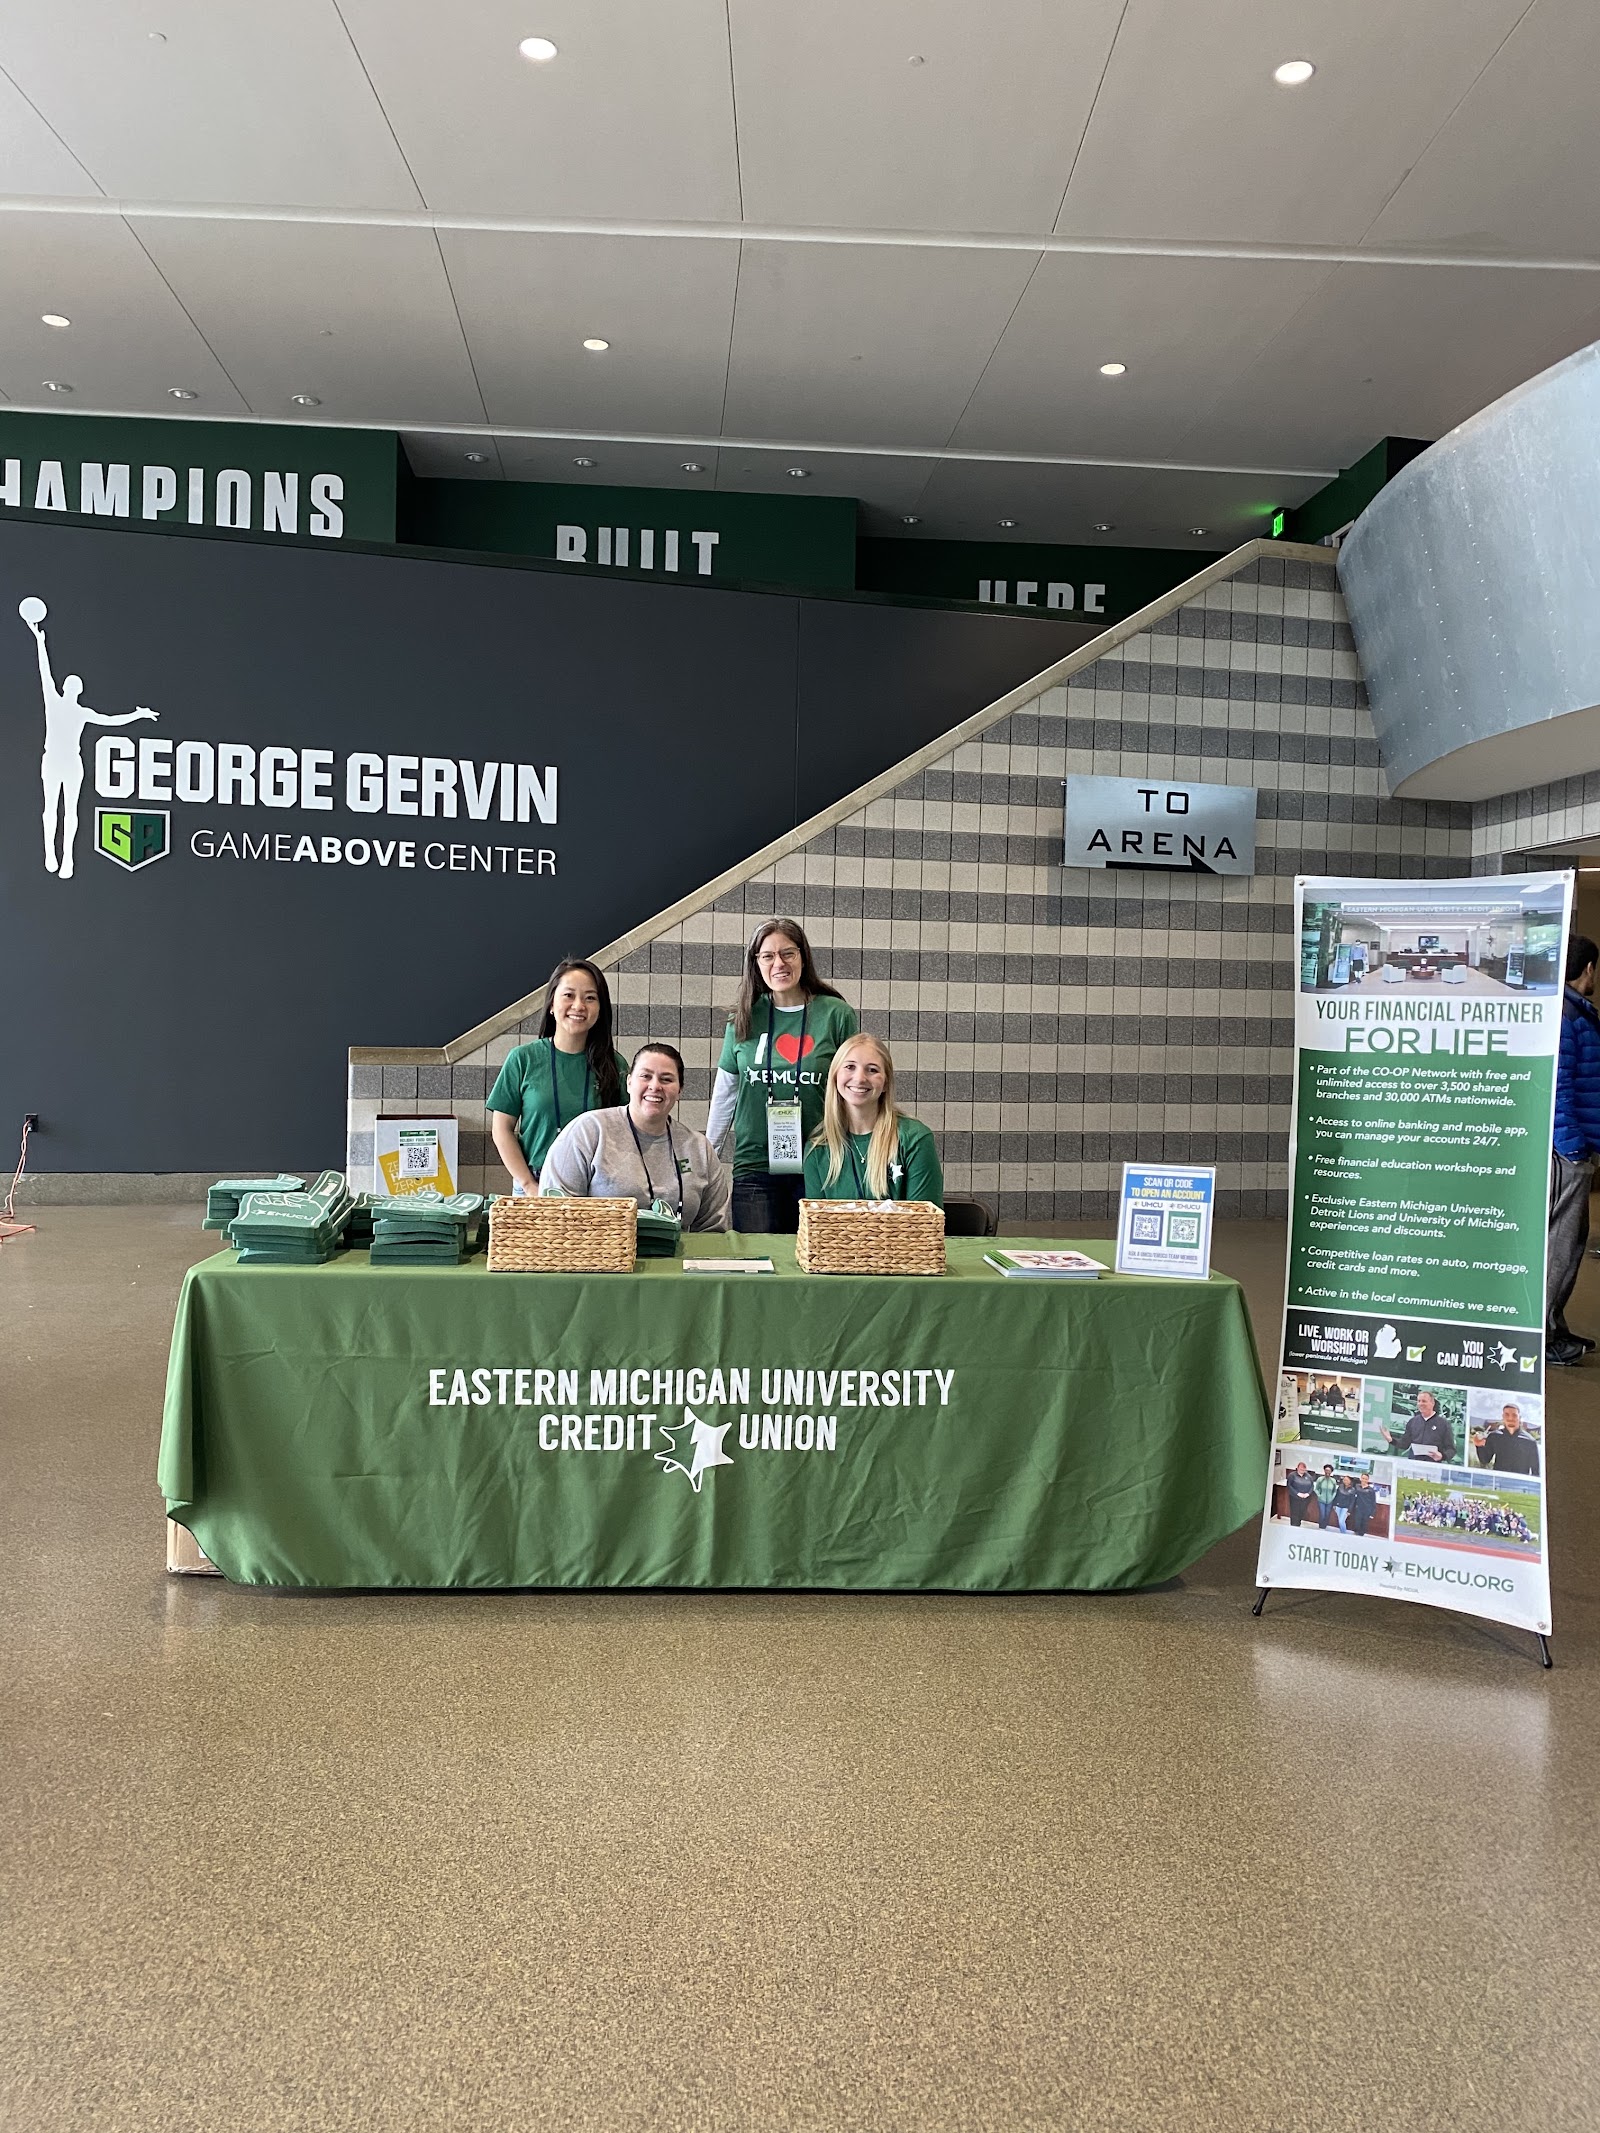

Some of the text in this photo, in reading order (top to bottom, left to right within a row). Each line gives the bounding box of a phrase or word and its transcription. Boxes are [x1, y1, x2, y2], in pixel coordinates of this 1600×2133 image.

[94, 736, 559, 825] GEORGE GERVIN
[1137, 789, 1190, 815] TO
[190, 830, 557, 876] GAMEABOVE CENTER
[1086, 829, 1238, 860] ARENA
[1316, 1000, 1543, 1024] YOUR FINANCIAL PARTNER
[754, 1032, 768, 1064] I
[1346, 1027, 1509, 1055] FOR LIFE
[762, 1070, 822, 1085] EMUCU
[1317, 1064, 1532, 1081] Part of the CO-OP Network with free and
[1316, 1078, 1510, 1092] unlimited access to over 3,500 shared
[1316, 1089, 1516, 1106] branches and 30,000 ATMs nationwide.
[1316, 1116, 1529, 1137] Access to online banking and mobile app,
[1316, 1130, 1500, 1146] you can manage your accounts 24/7.
[1314, 1168, 1362, 1180] resources.
[1315, 1154, 1516, 1176] Free financial education workshops and
[394, 1178, 424, 1192] ZERO
[1144, 1177, 1194, 1188] SCAN QR CODE
[1131, 1187, 1206, 1200] TO OPEN AN ACCOUNT
[266, 1210, 314, 1221] EMUCU
[1312, 1194, 1506, 1218] Exclusive Eastern Michigan University,
[1310, 1206, 1520, 1232] Detroit Lions and University of Michigan,
[1310, 1221, 1446, 1238] experiences and discounts.
[1306, 1260, 1420, 1277] credit cards and more.
[1308, 1246, 1528, 1274] Competitive loan rates on auto, mortgage,
[1304, 1286, 1519, 1314] Active in the local communities we serve.
[1298, 1324, 1370, 1344] LIVE, WORK OR
[1311, 1338, 1369, 1357] WORSHIP IN
[1462, 1340, 1484, 1355] YOU
[1436, 1352, 1484, 1370] CAN JOIN
[429, 1366, 955, 1408] EASTERN MICHIGAN UNIVERSITY
[538, 1413, 837, 1452] CREDIT UNION
[1288, 1544, 1514, 1593] START TODAY EMUCU.ORG
